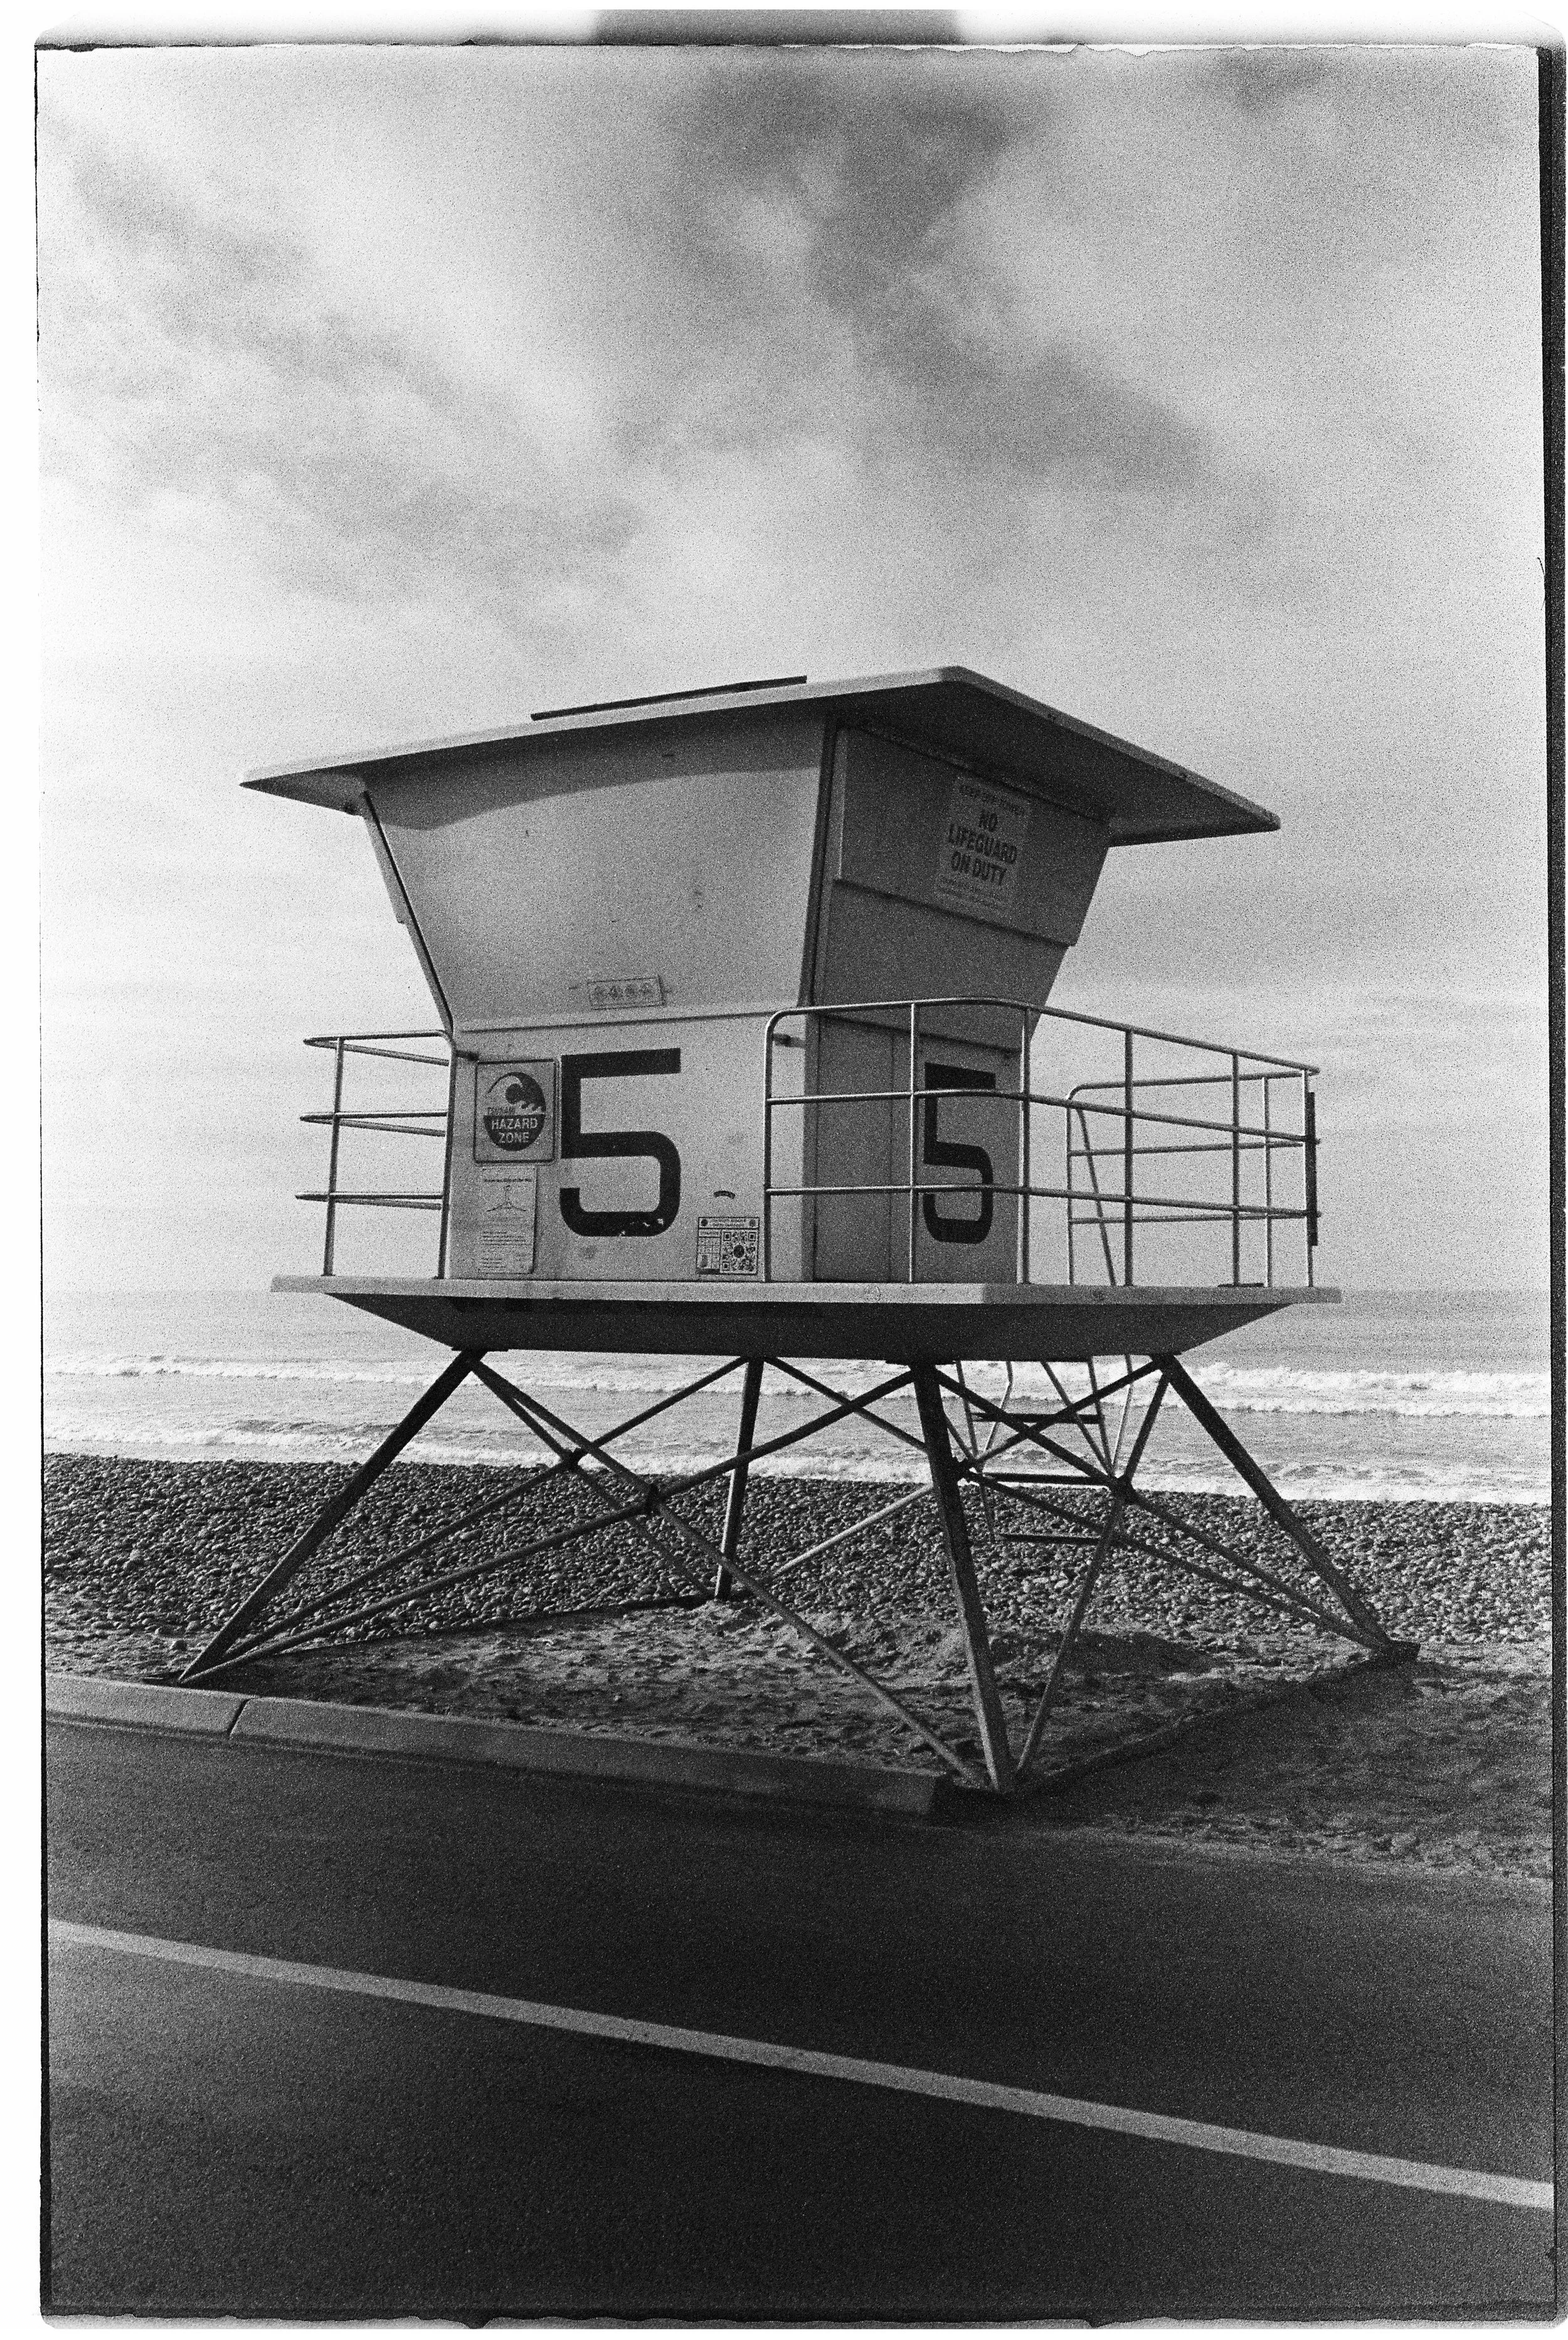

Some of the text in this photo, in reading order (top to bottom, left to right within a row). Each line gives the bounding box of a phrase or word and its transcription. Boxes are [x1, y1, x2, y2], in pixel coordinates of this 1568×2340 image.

[978, 811, 998, 832] NO
[948, 824, 1017, 864] LIFEGUARD
[951, 851, 1007, 886] ON DUTY
[491, 1118, 538, 1130] HAZARD
[498, 1132, 529, 1144] ZONE
[559, 1048, 681, 1237] 5
[923, 1062, 996, 1244] 5
